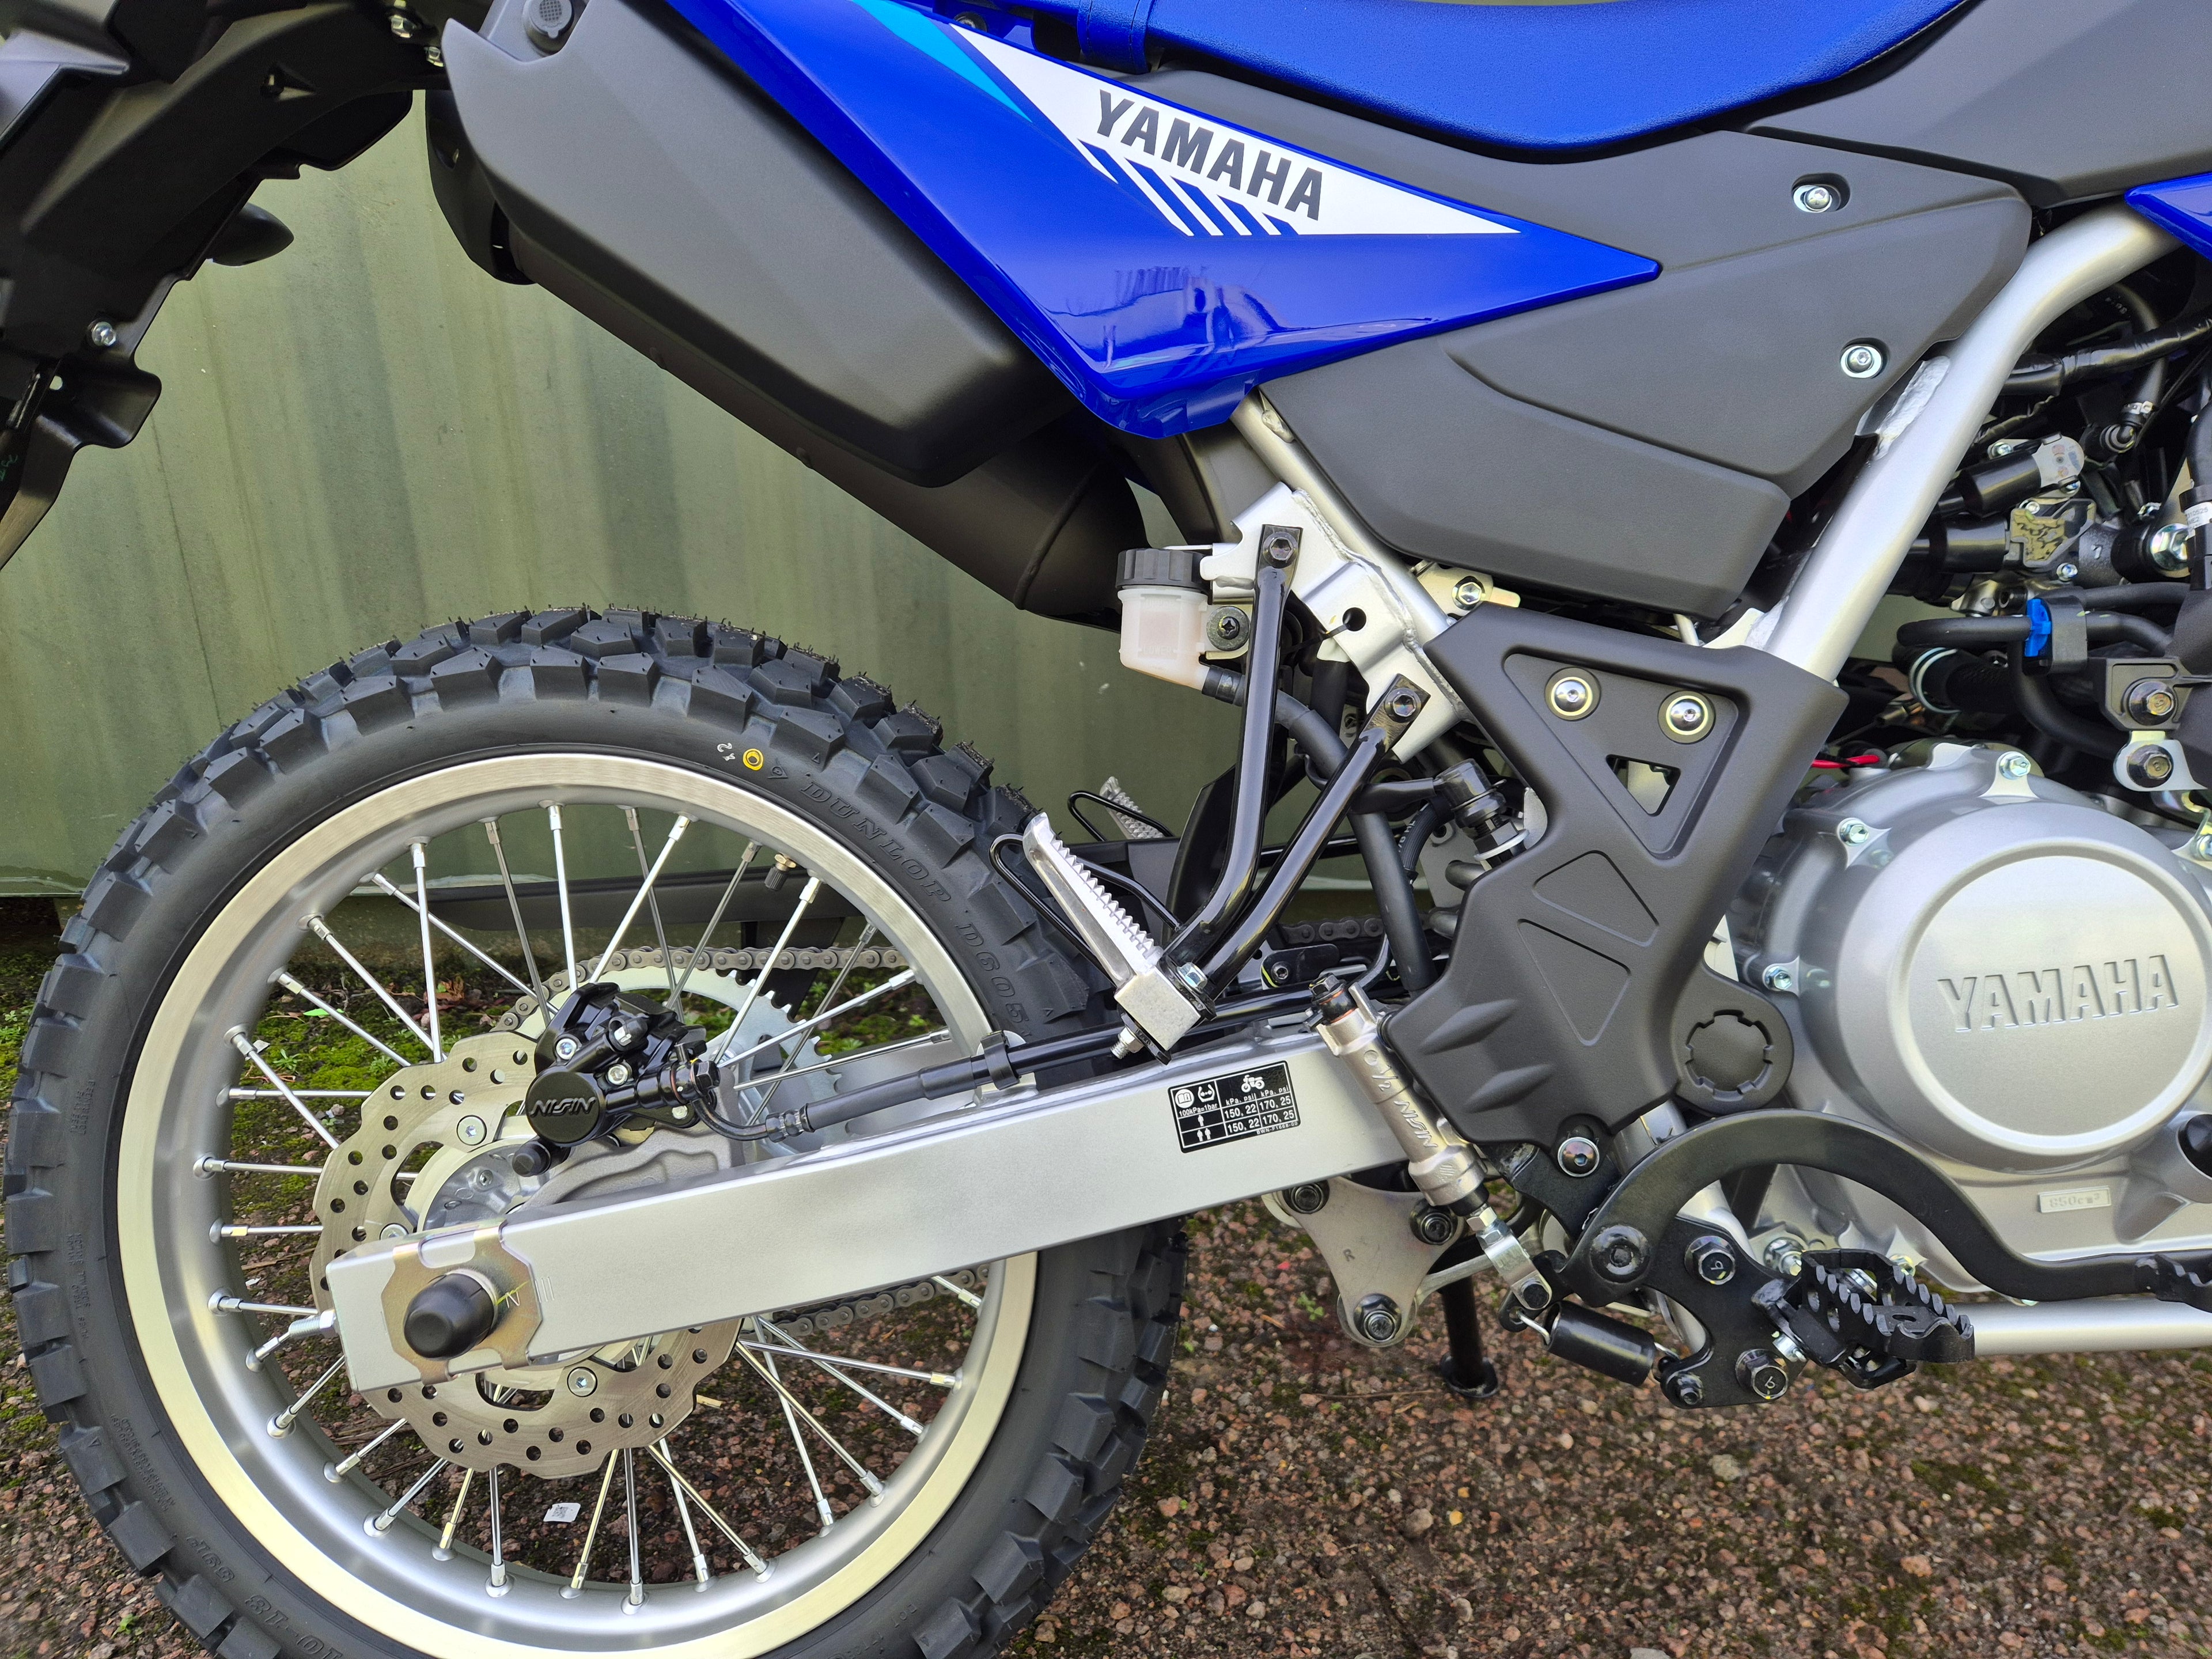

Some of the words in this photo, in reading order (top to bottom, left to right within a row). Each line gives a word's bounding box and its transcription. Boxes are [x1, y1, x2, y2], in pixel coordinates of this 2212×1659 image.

[1097, 89, 1323, 221] YAMAHA
[800, 781, 952, 903] DUNLOP
[954, 923, 1029, 1023] D605
[1937, 954, 2179, 1032] YAMAHA
[530, 1096, 597, 1118] NISSIN
[1179, 1102, 1218, 1118] 100kPa=1bar
[1225, 1107, 1244, 1119] 150,
[1245, 1103, 1257, 1115] 22
[1259, 1099, 1279, 1111] 170,
[1280, 1095, 1291, 1107] 25
[1228, 1121, 1247, 1134] 150,
[1249, 1118, 1260, 1129] 22
[1262, 1113, 1282, 1126] 170,
[1283, 1109, 1295, 1121] 25
[1393, 1100, 1439, 1147] NISSIN
[1343, 1249, 1355, 1262] R
[186, 1536, 234, 1582] 59P
